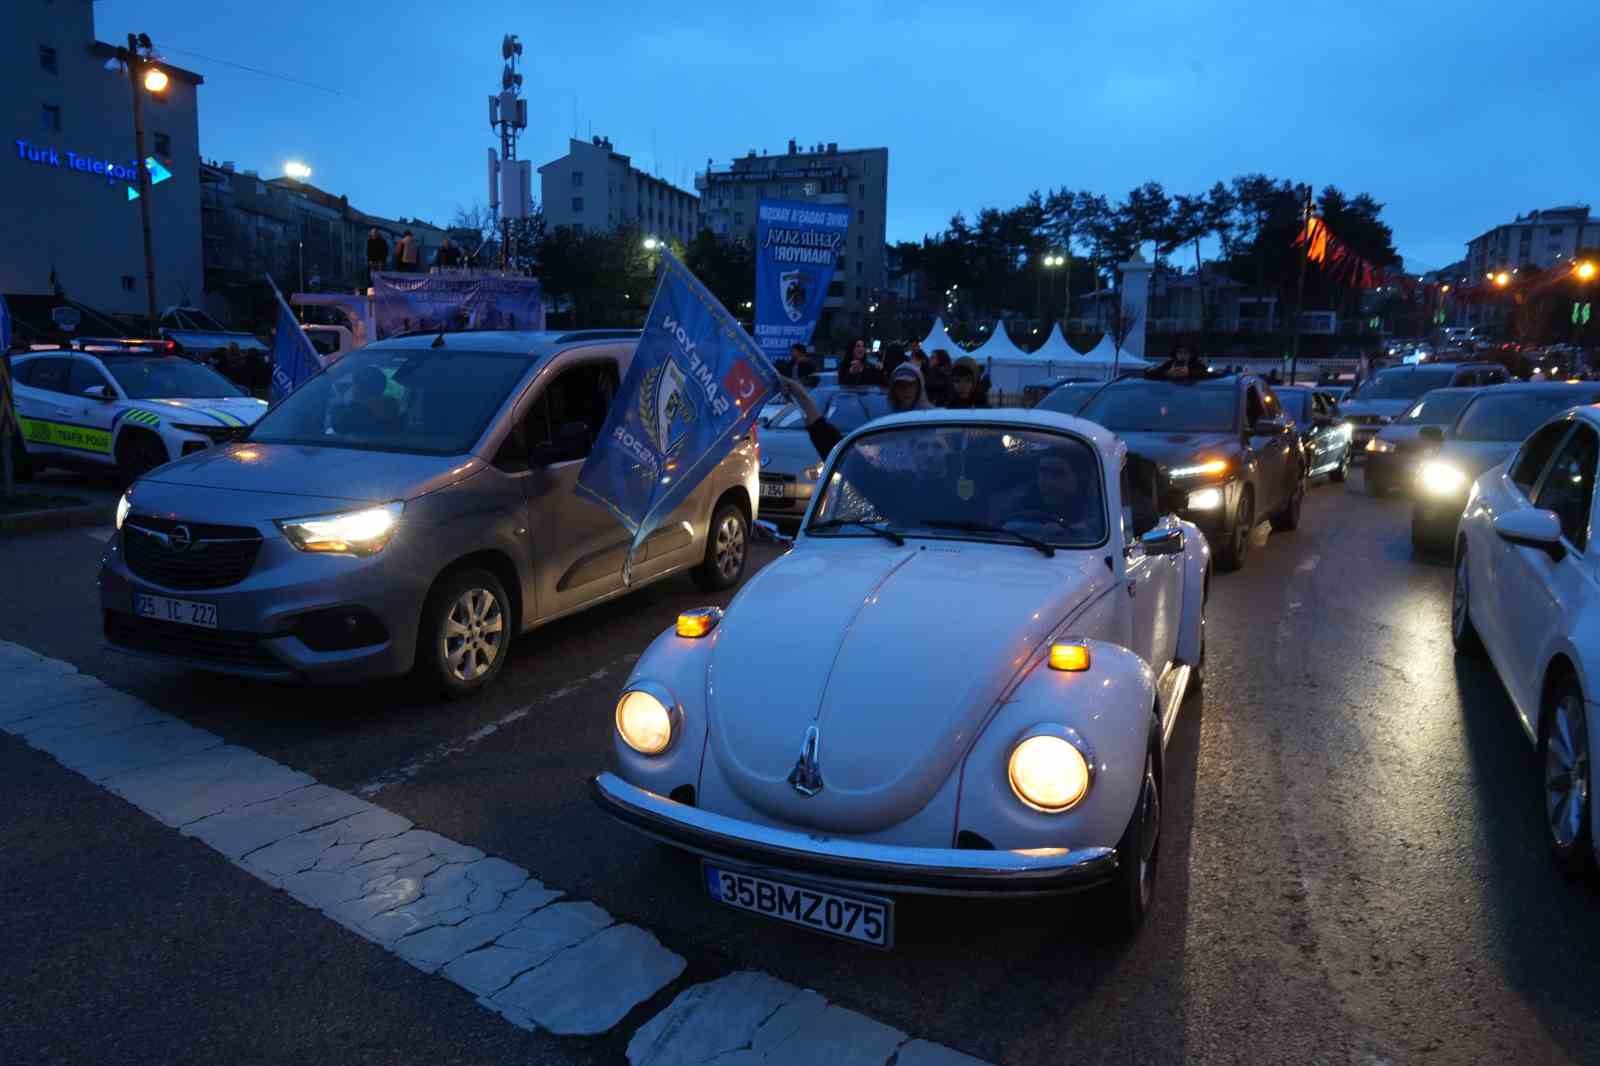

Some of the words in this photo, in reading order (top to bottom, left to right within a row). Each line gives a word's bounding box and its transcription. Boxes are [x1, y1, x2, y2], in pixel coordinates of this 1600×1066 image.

[16, 138, 61, 167] Türk
[167, 600, 183, 619] TC
[192, 604, 215, 624] 222
[721, 874, 882, 939] 35BMZ075
